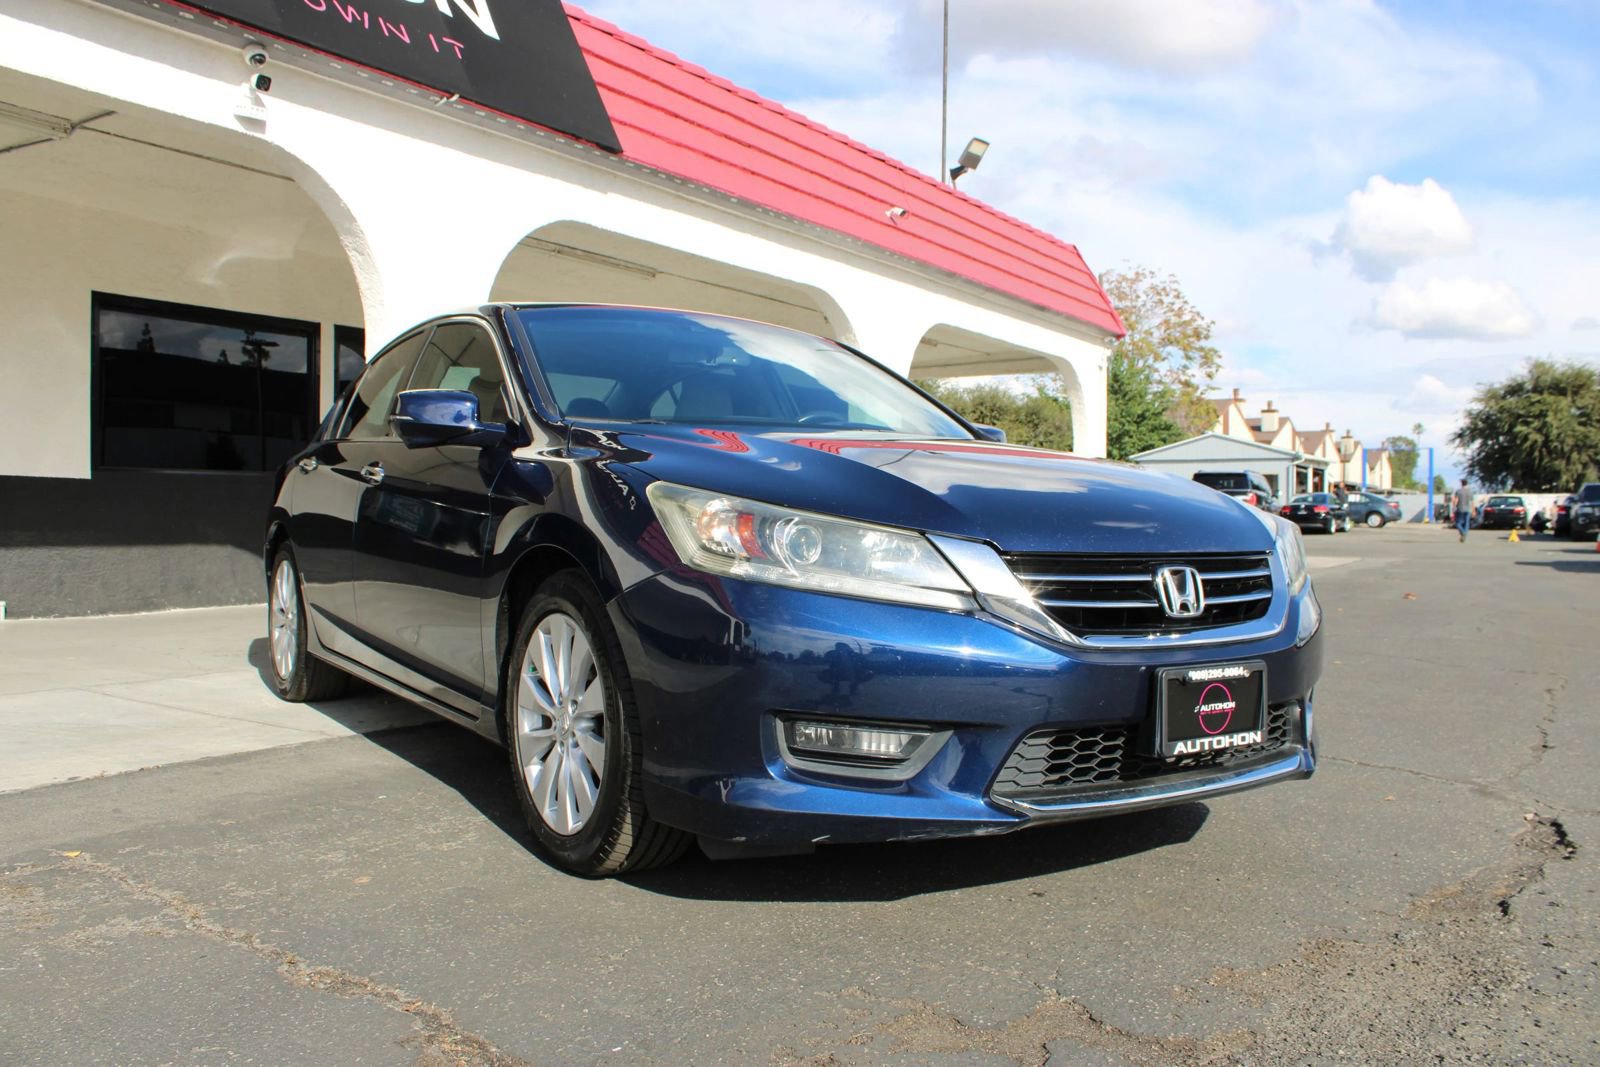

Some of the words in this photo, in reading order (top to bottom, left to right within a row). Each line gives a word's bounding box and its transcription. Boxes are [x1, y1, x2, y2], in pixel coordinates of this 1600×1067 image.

[428, 33, 465, 60] IT
[1200, 701, 1236, 712] AUTOHON
[1173, 731, 1262, 755] AUTOHON
